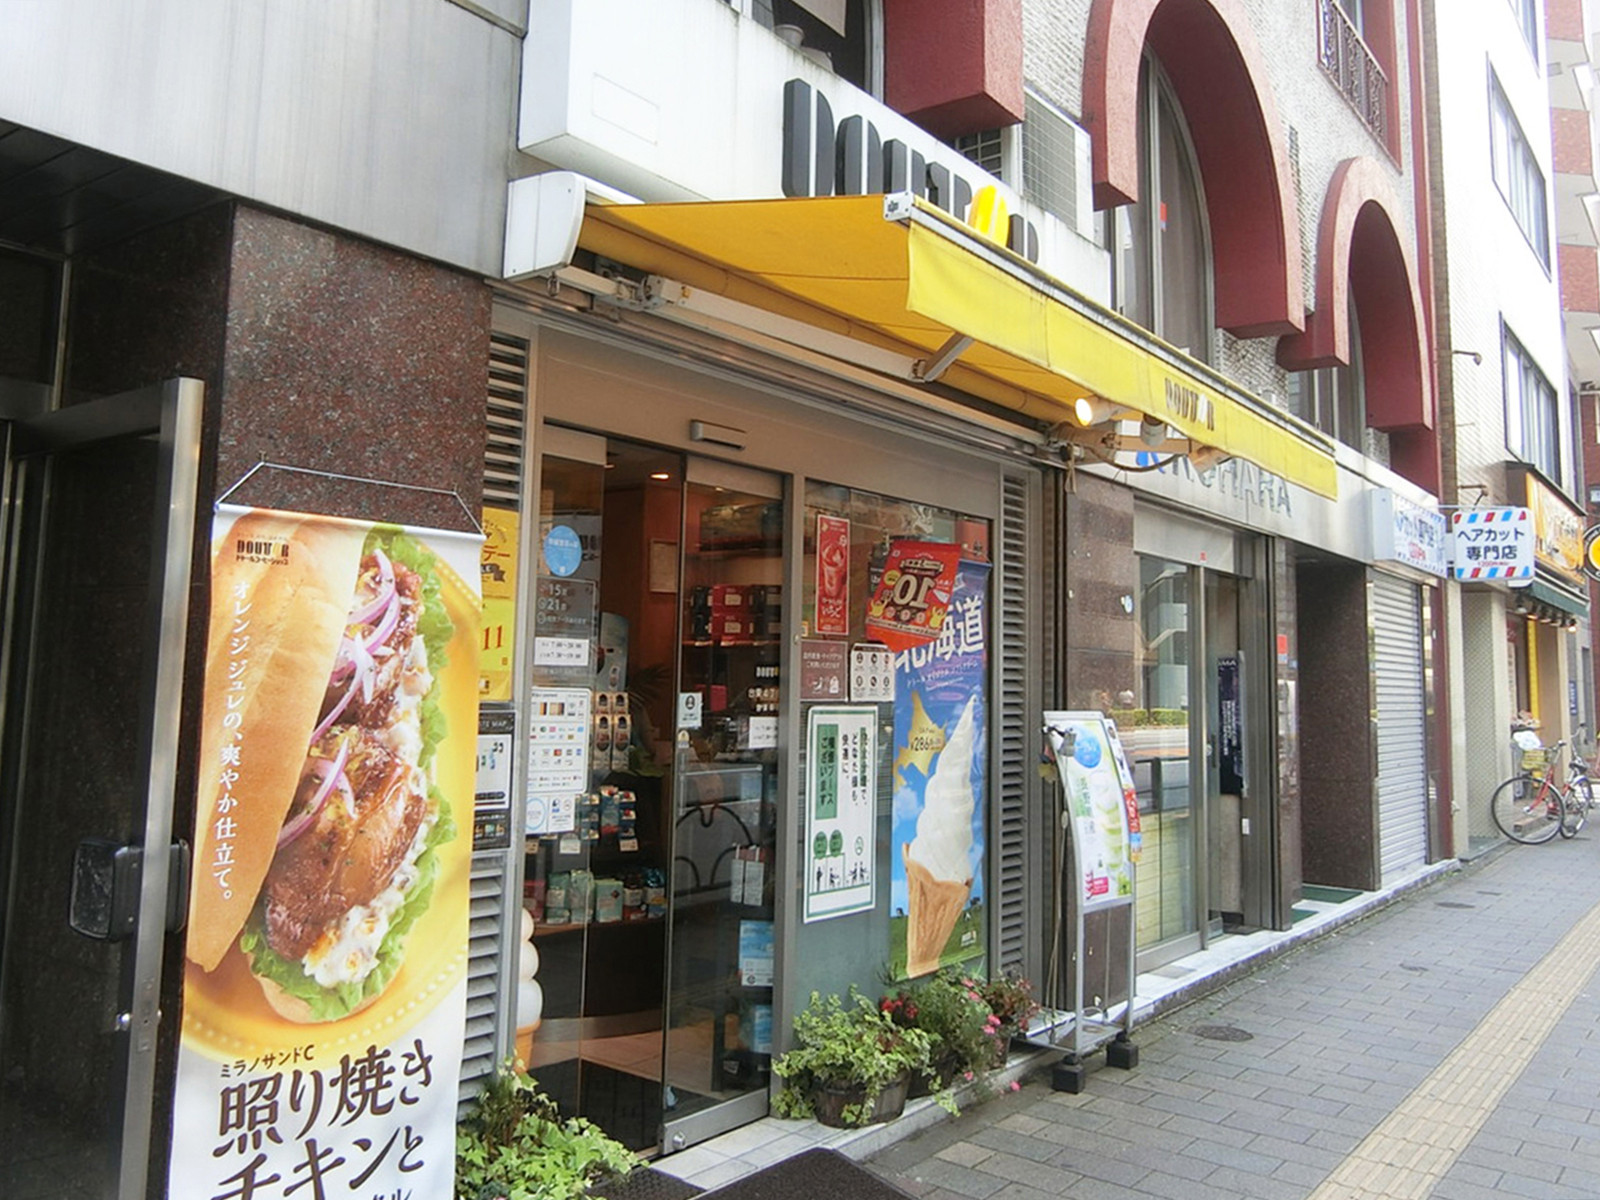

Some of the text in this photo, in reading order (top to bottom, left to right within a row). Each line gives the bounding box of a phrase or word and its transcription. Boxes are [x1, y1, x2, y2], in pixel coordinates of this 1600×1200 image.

[1165, 377, 1214, 432] DOUTOR
[237, 540, 289, 557] DOUTOR
[1457, 528, 1525, 542] ヘアカット
[1466, 545, 1518, 561] 専門店
[212, 580, 252, 900] オレンジジュレの、爽やか仕立て。
[220, 1045, 315, 1078] ミラノサンドC
[212, 1039, 432, 1157] 照り焼き
[210, 1125, 424, 1200] チキンと
